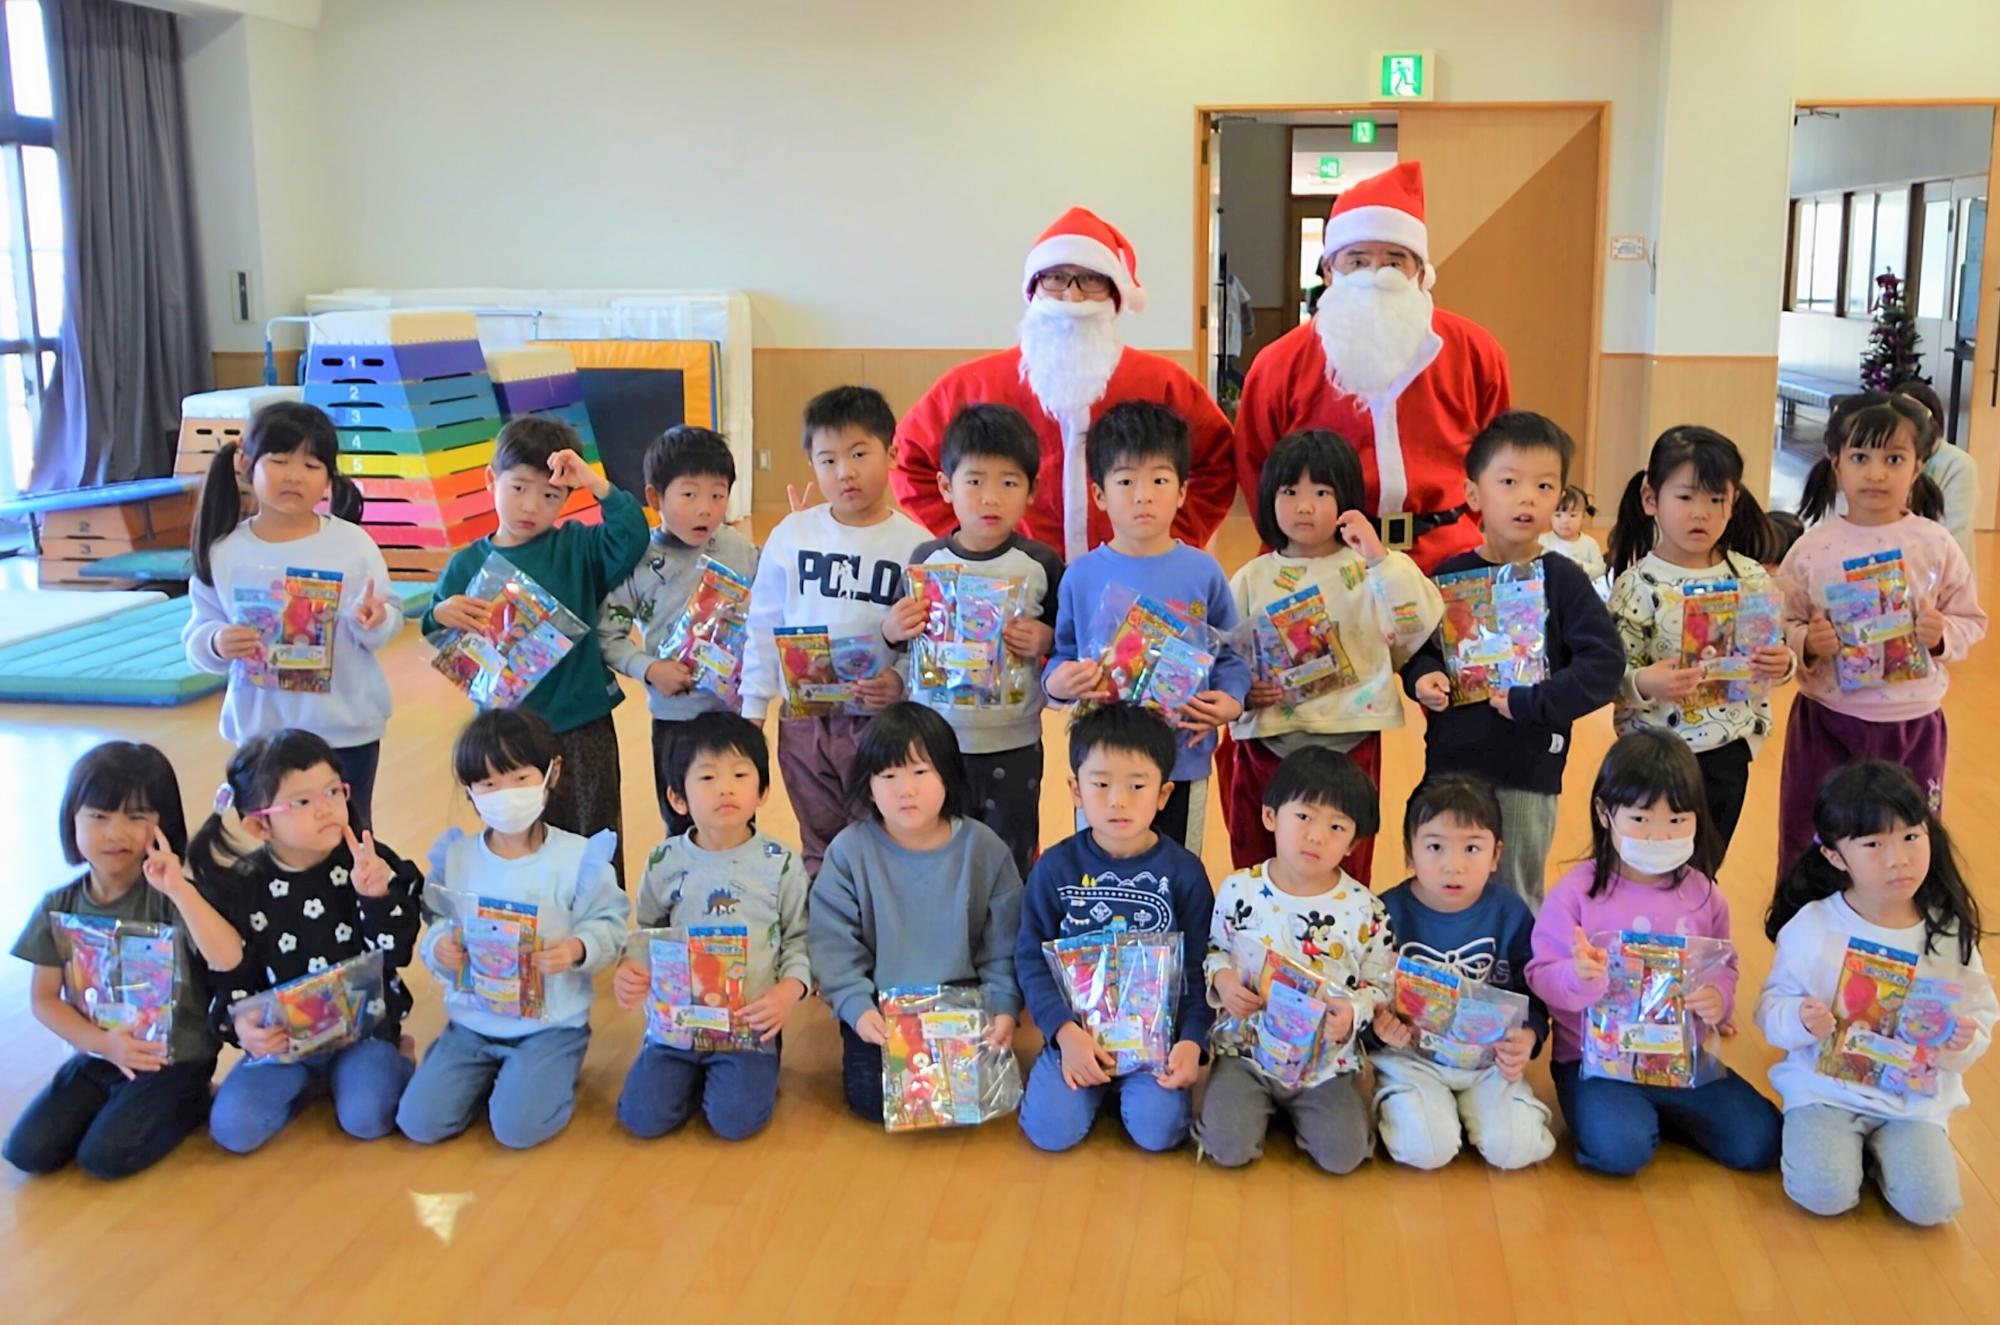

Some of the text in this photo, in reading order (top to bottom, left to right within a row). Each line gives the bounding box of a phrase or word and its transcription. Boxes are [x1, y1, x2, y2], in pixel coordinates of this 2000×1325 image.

[349, 355, 356, 369] 1
[349, 385, 359, 400] 2
[351, 409, 361, 423] 3
[352, 434, 361, 448] 4
[798, 549, 902, 606] POLO
